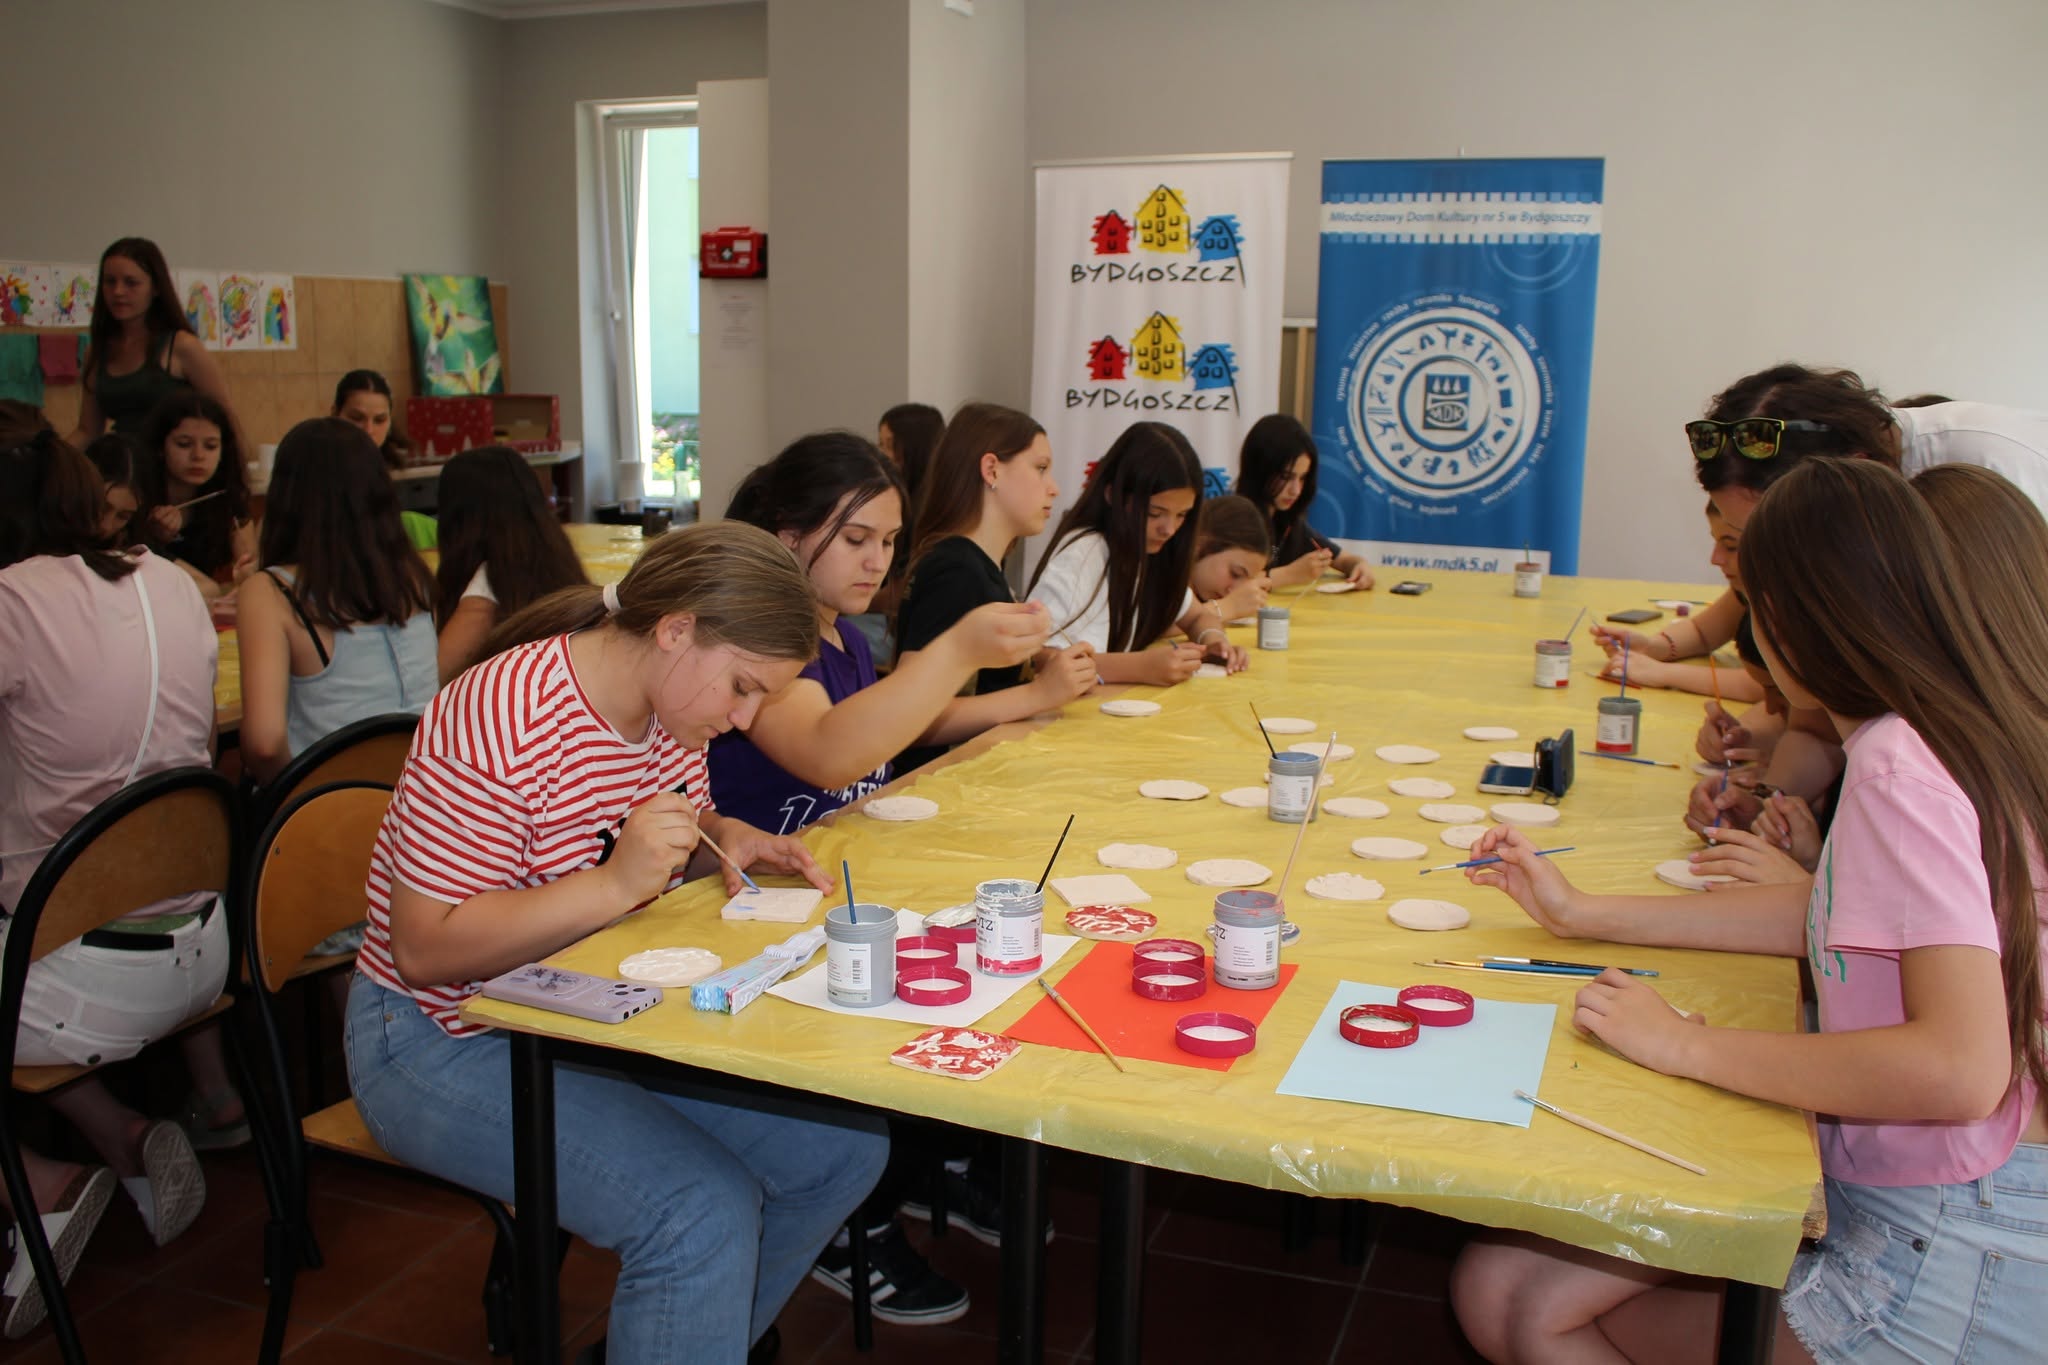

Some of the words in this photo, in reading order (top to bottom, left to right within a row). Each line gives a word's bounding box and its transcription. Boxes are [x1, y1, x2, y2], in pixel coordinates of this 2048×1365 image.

[1407, 210, 1434, 222] Dom
[1438, 209, 1479, 225] Kultury
[1498, 210, 1506, 222] 5
[1520, 209, 1592, 225] Bydgoszczy
[1071, 261, 1236, 284] BYDGOSZCZ
[1065, 387, 1231, 410] BYDGOSZCZ
[1381, 553, 1499, 573] www.mdk5.pl
